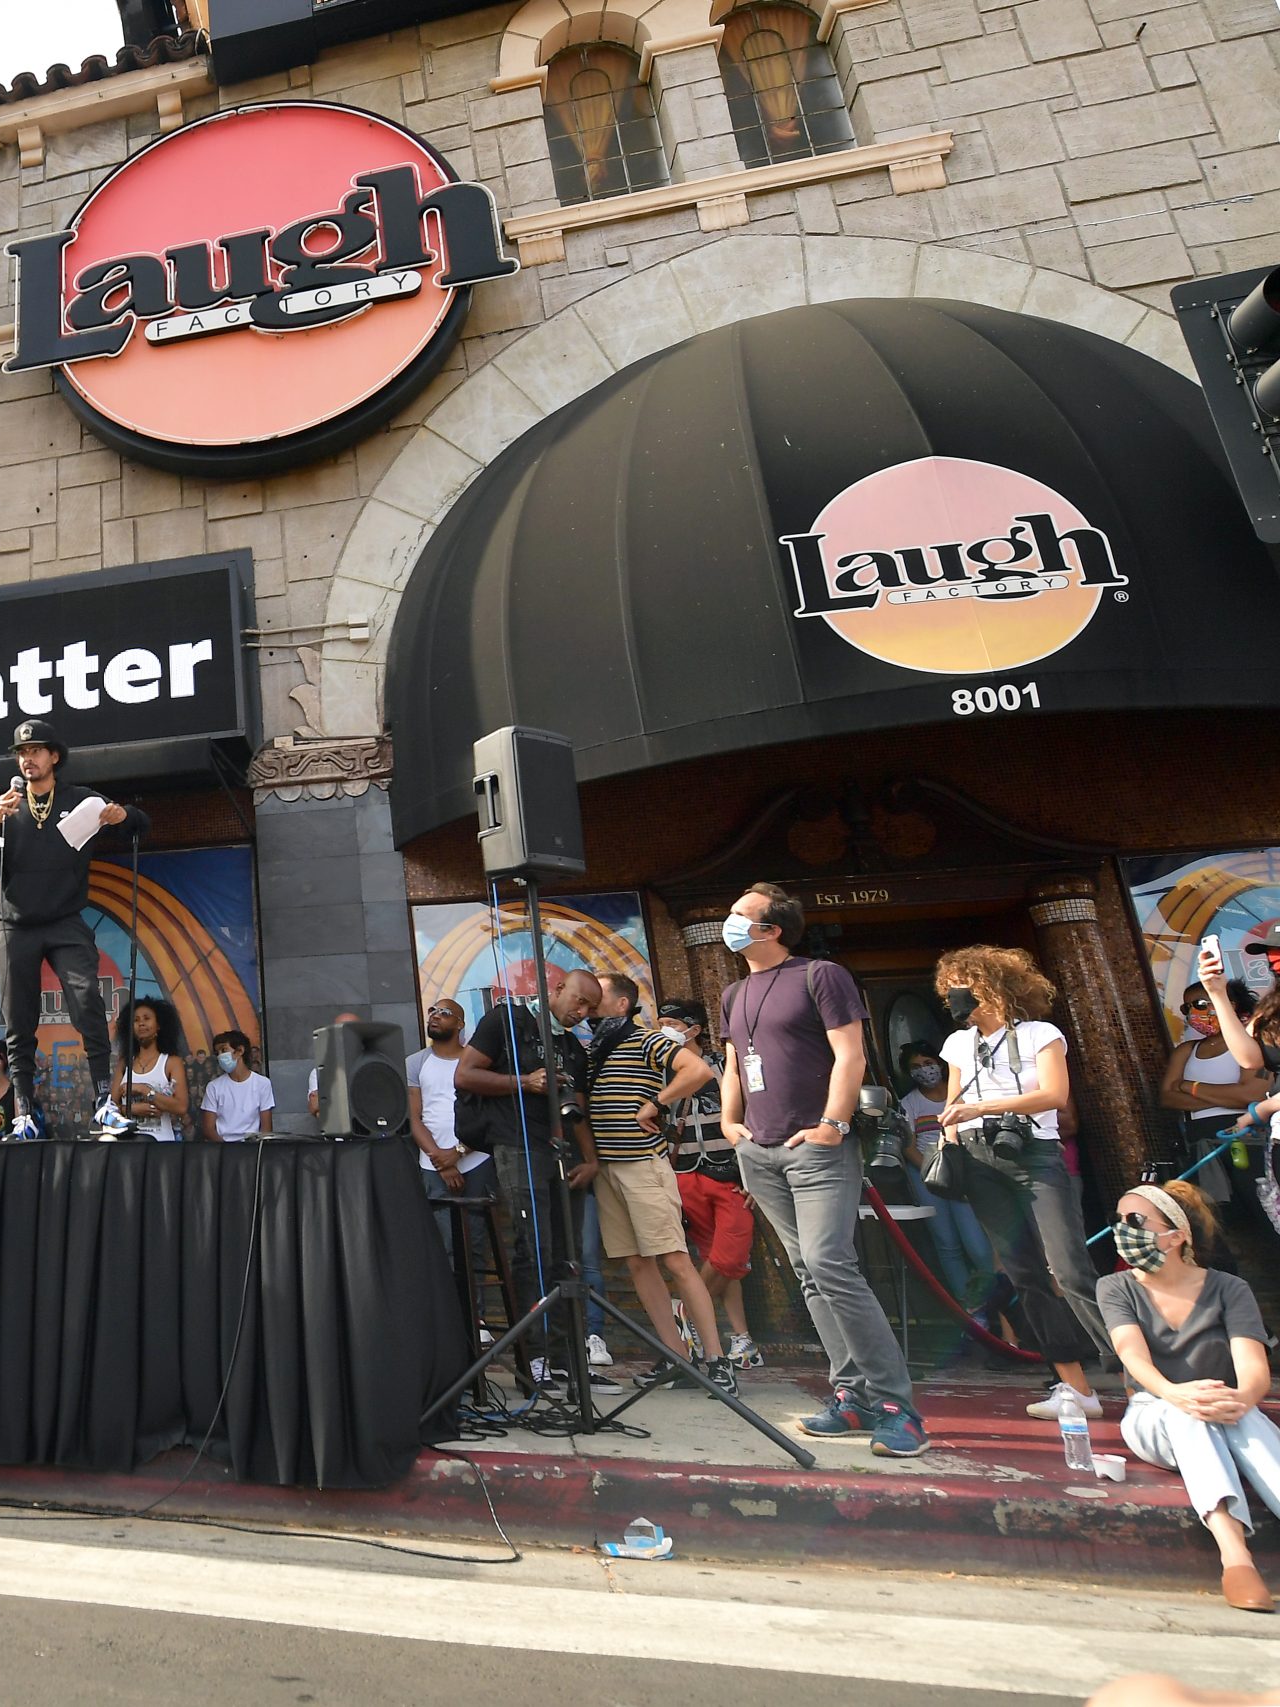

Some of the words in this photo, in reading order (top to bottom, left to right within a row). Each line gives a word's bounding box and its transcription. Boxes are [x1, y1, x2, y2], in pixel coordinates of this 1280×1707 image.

[2, 162, 520, 373] Laugh
[156, 274, 410, 338] FACTORY
[779, 513, 1129, 618] Laugh
[903, 577, 1056, 602] FACTORY
[951, 682, 1041, 715] 8001
[851, 889, 889, 904] 1979
